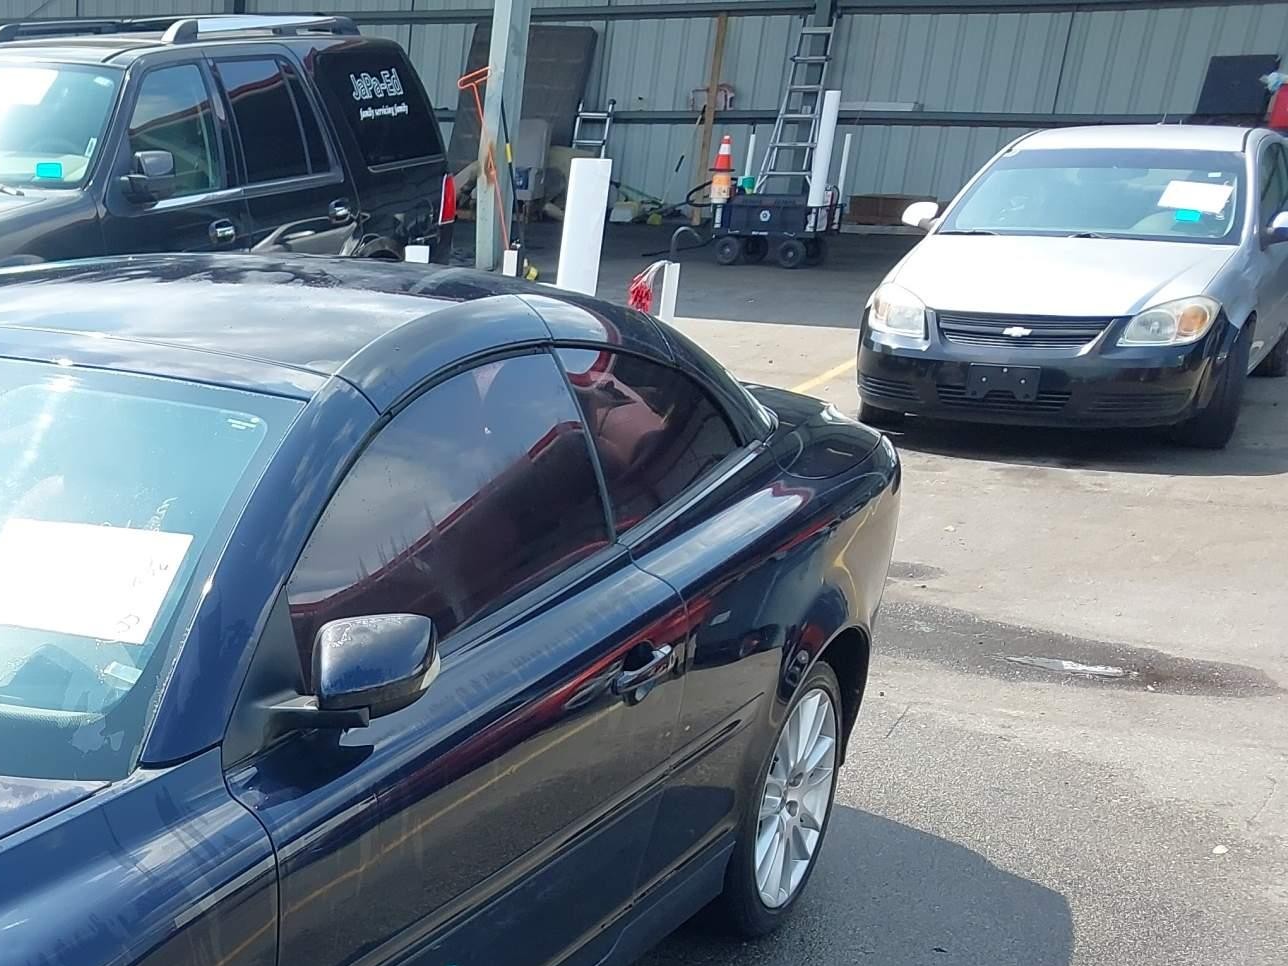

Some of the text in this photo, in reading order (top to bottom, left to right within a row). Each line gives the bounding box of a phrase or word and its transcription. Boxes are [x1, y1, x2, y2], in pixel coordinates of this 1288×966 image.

[349, 67, 404, 100] JaPa-Ed
[359, 106, 374, 121] family
[393, 102, 409, 116] family
